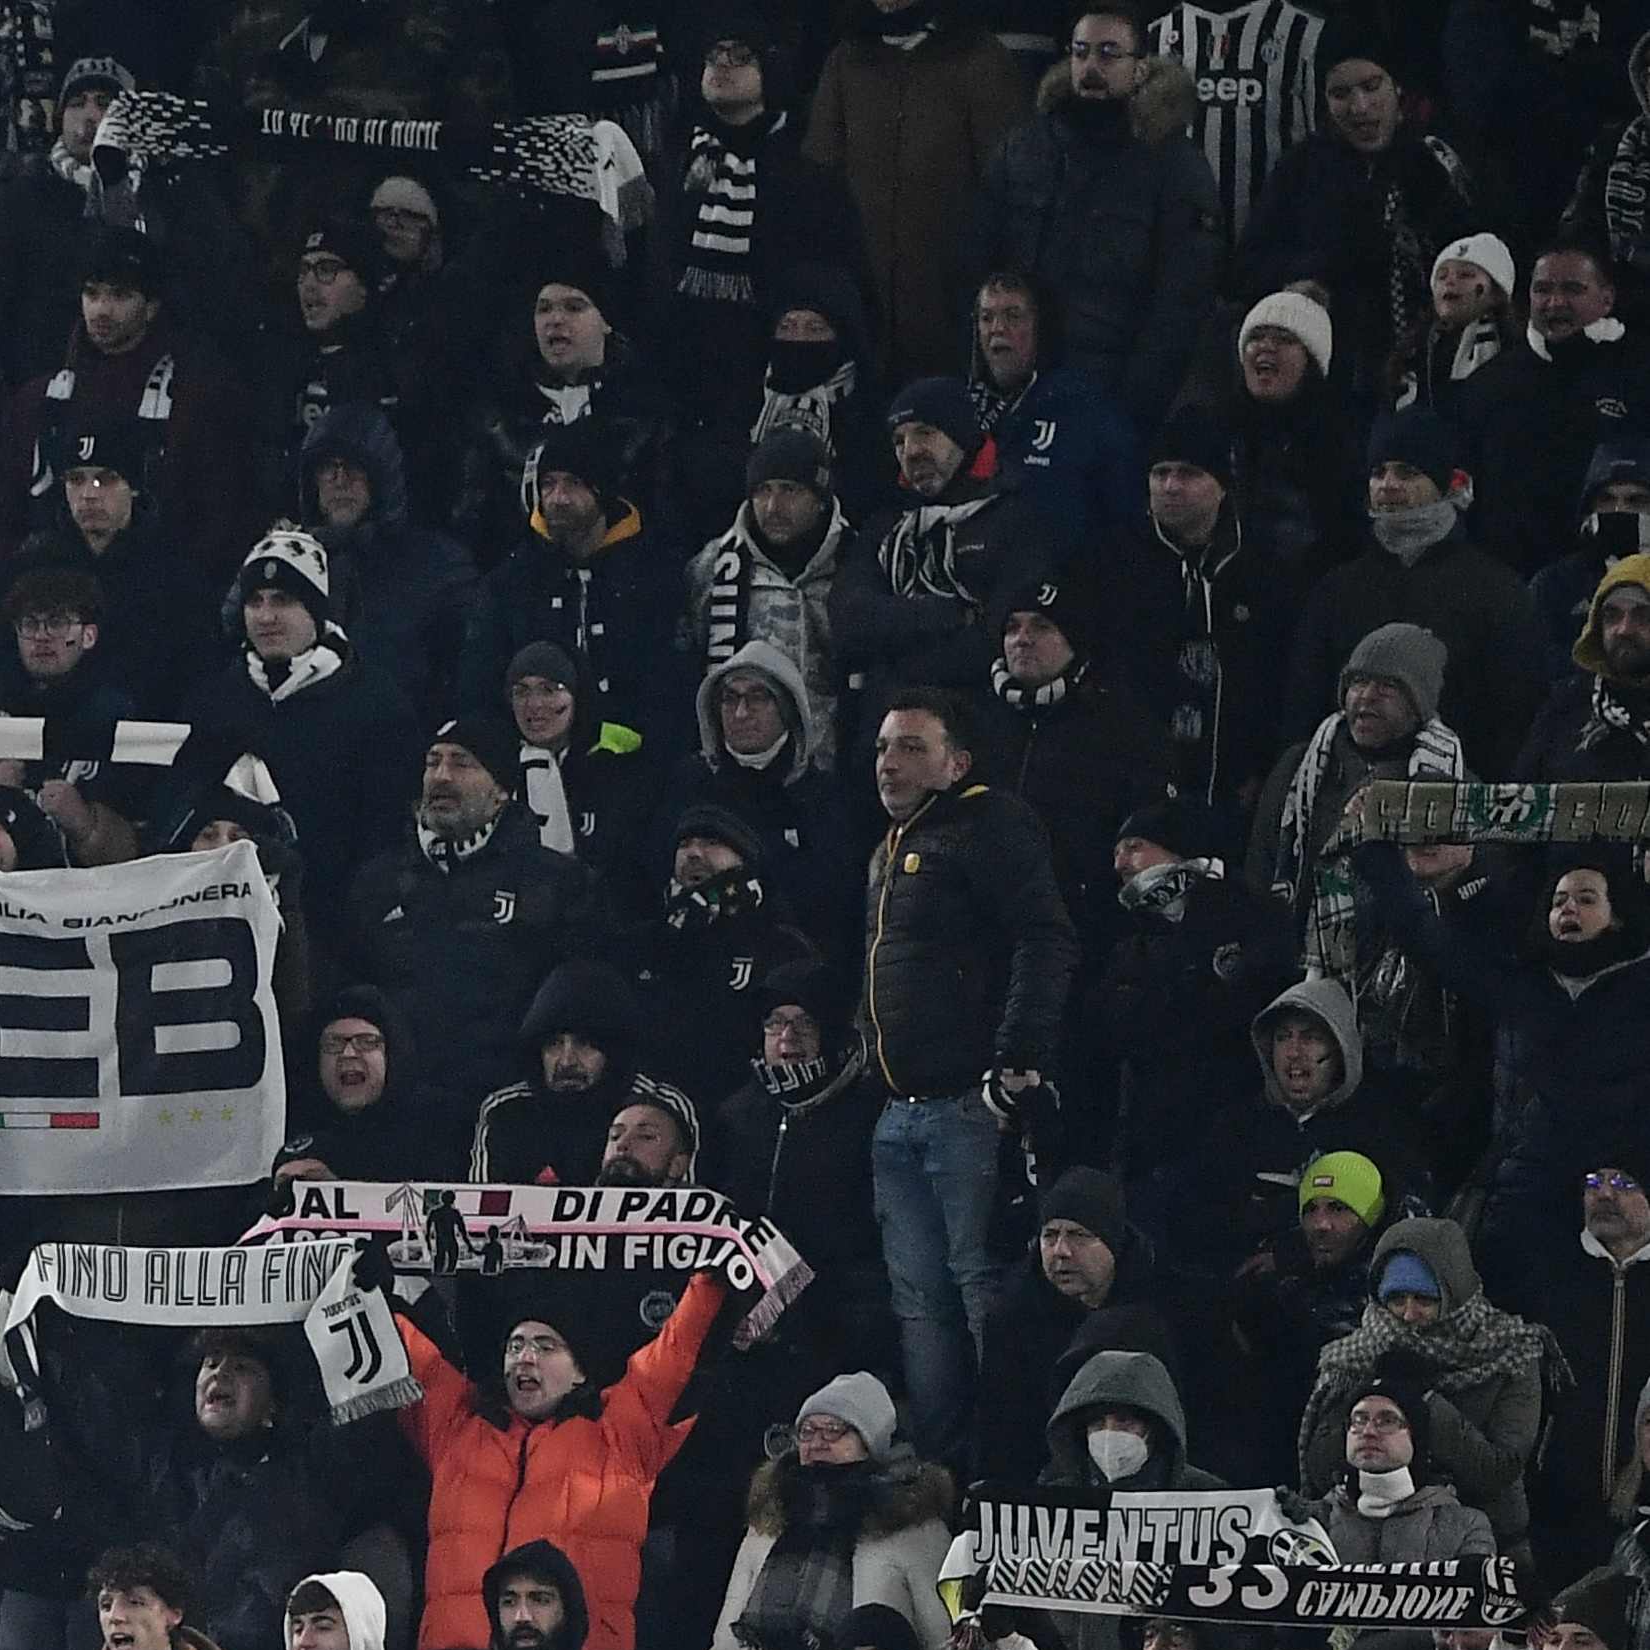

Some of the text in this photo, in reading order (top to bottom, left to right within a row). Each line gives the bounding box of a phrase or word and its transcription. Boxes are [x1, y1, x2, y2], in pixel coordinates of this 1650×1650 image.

[1197, 74, 1263, 106] eep
[62, 881, 252, 929] BIANNERA
[552, 1189, 602, 1223] DI
[36, 1241, 128, 1301] FINO
[144, 1247, 247, 1305] ALLA
[557, 1232, 754, 1292] IN FIGLIO
[973, 1500, 1253, 1568] JUVENTUS
